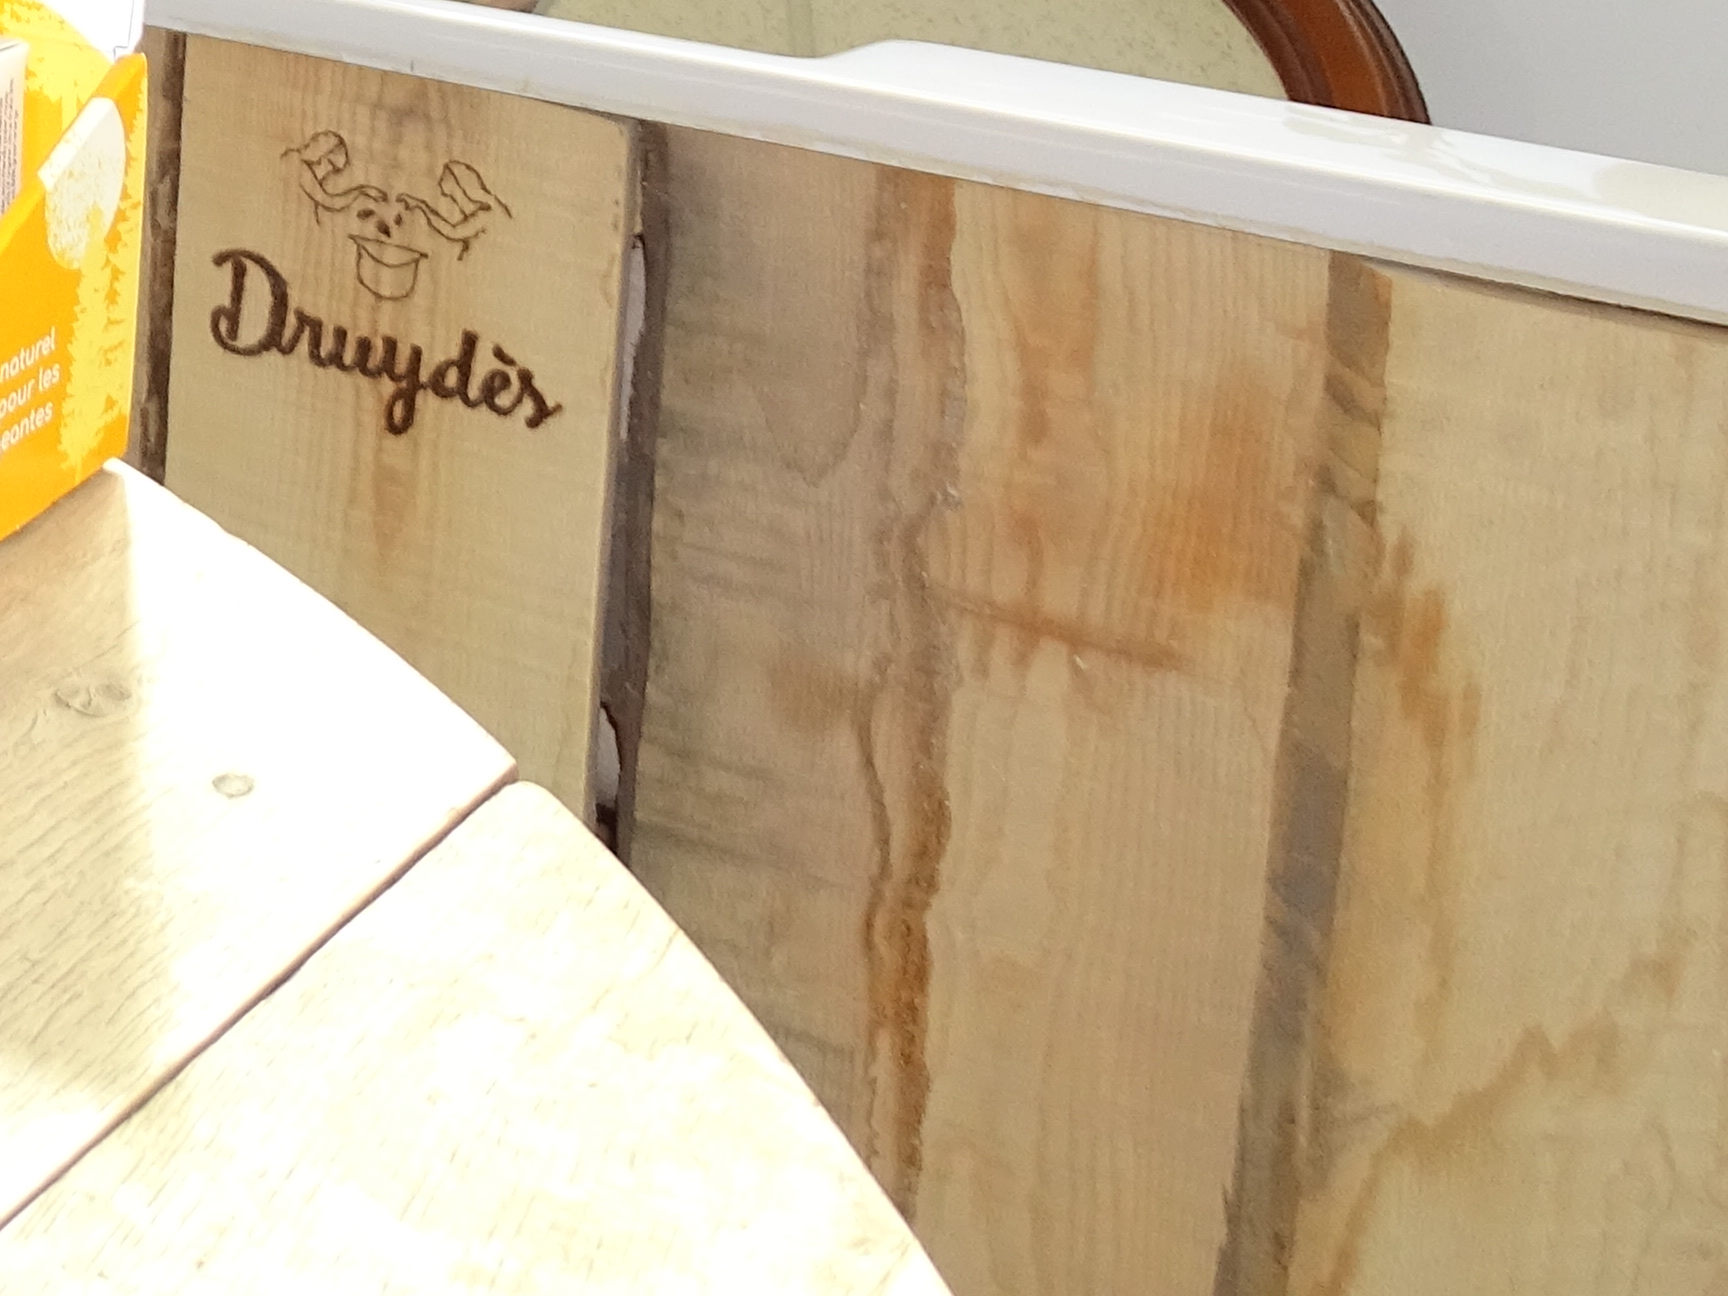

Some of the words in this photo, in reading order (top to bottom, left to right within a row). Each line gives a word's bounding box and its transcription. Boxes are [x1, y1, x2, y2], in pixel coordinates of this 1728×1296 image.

[0, 326, 56, 383] naturel
[210, 249, 563, 435] Druydès
[39, 363, 60, 392] les
